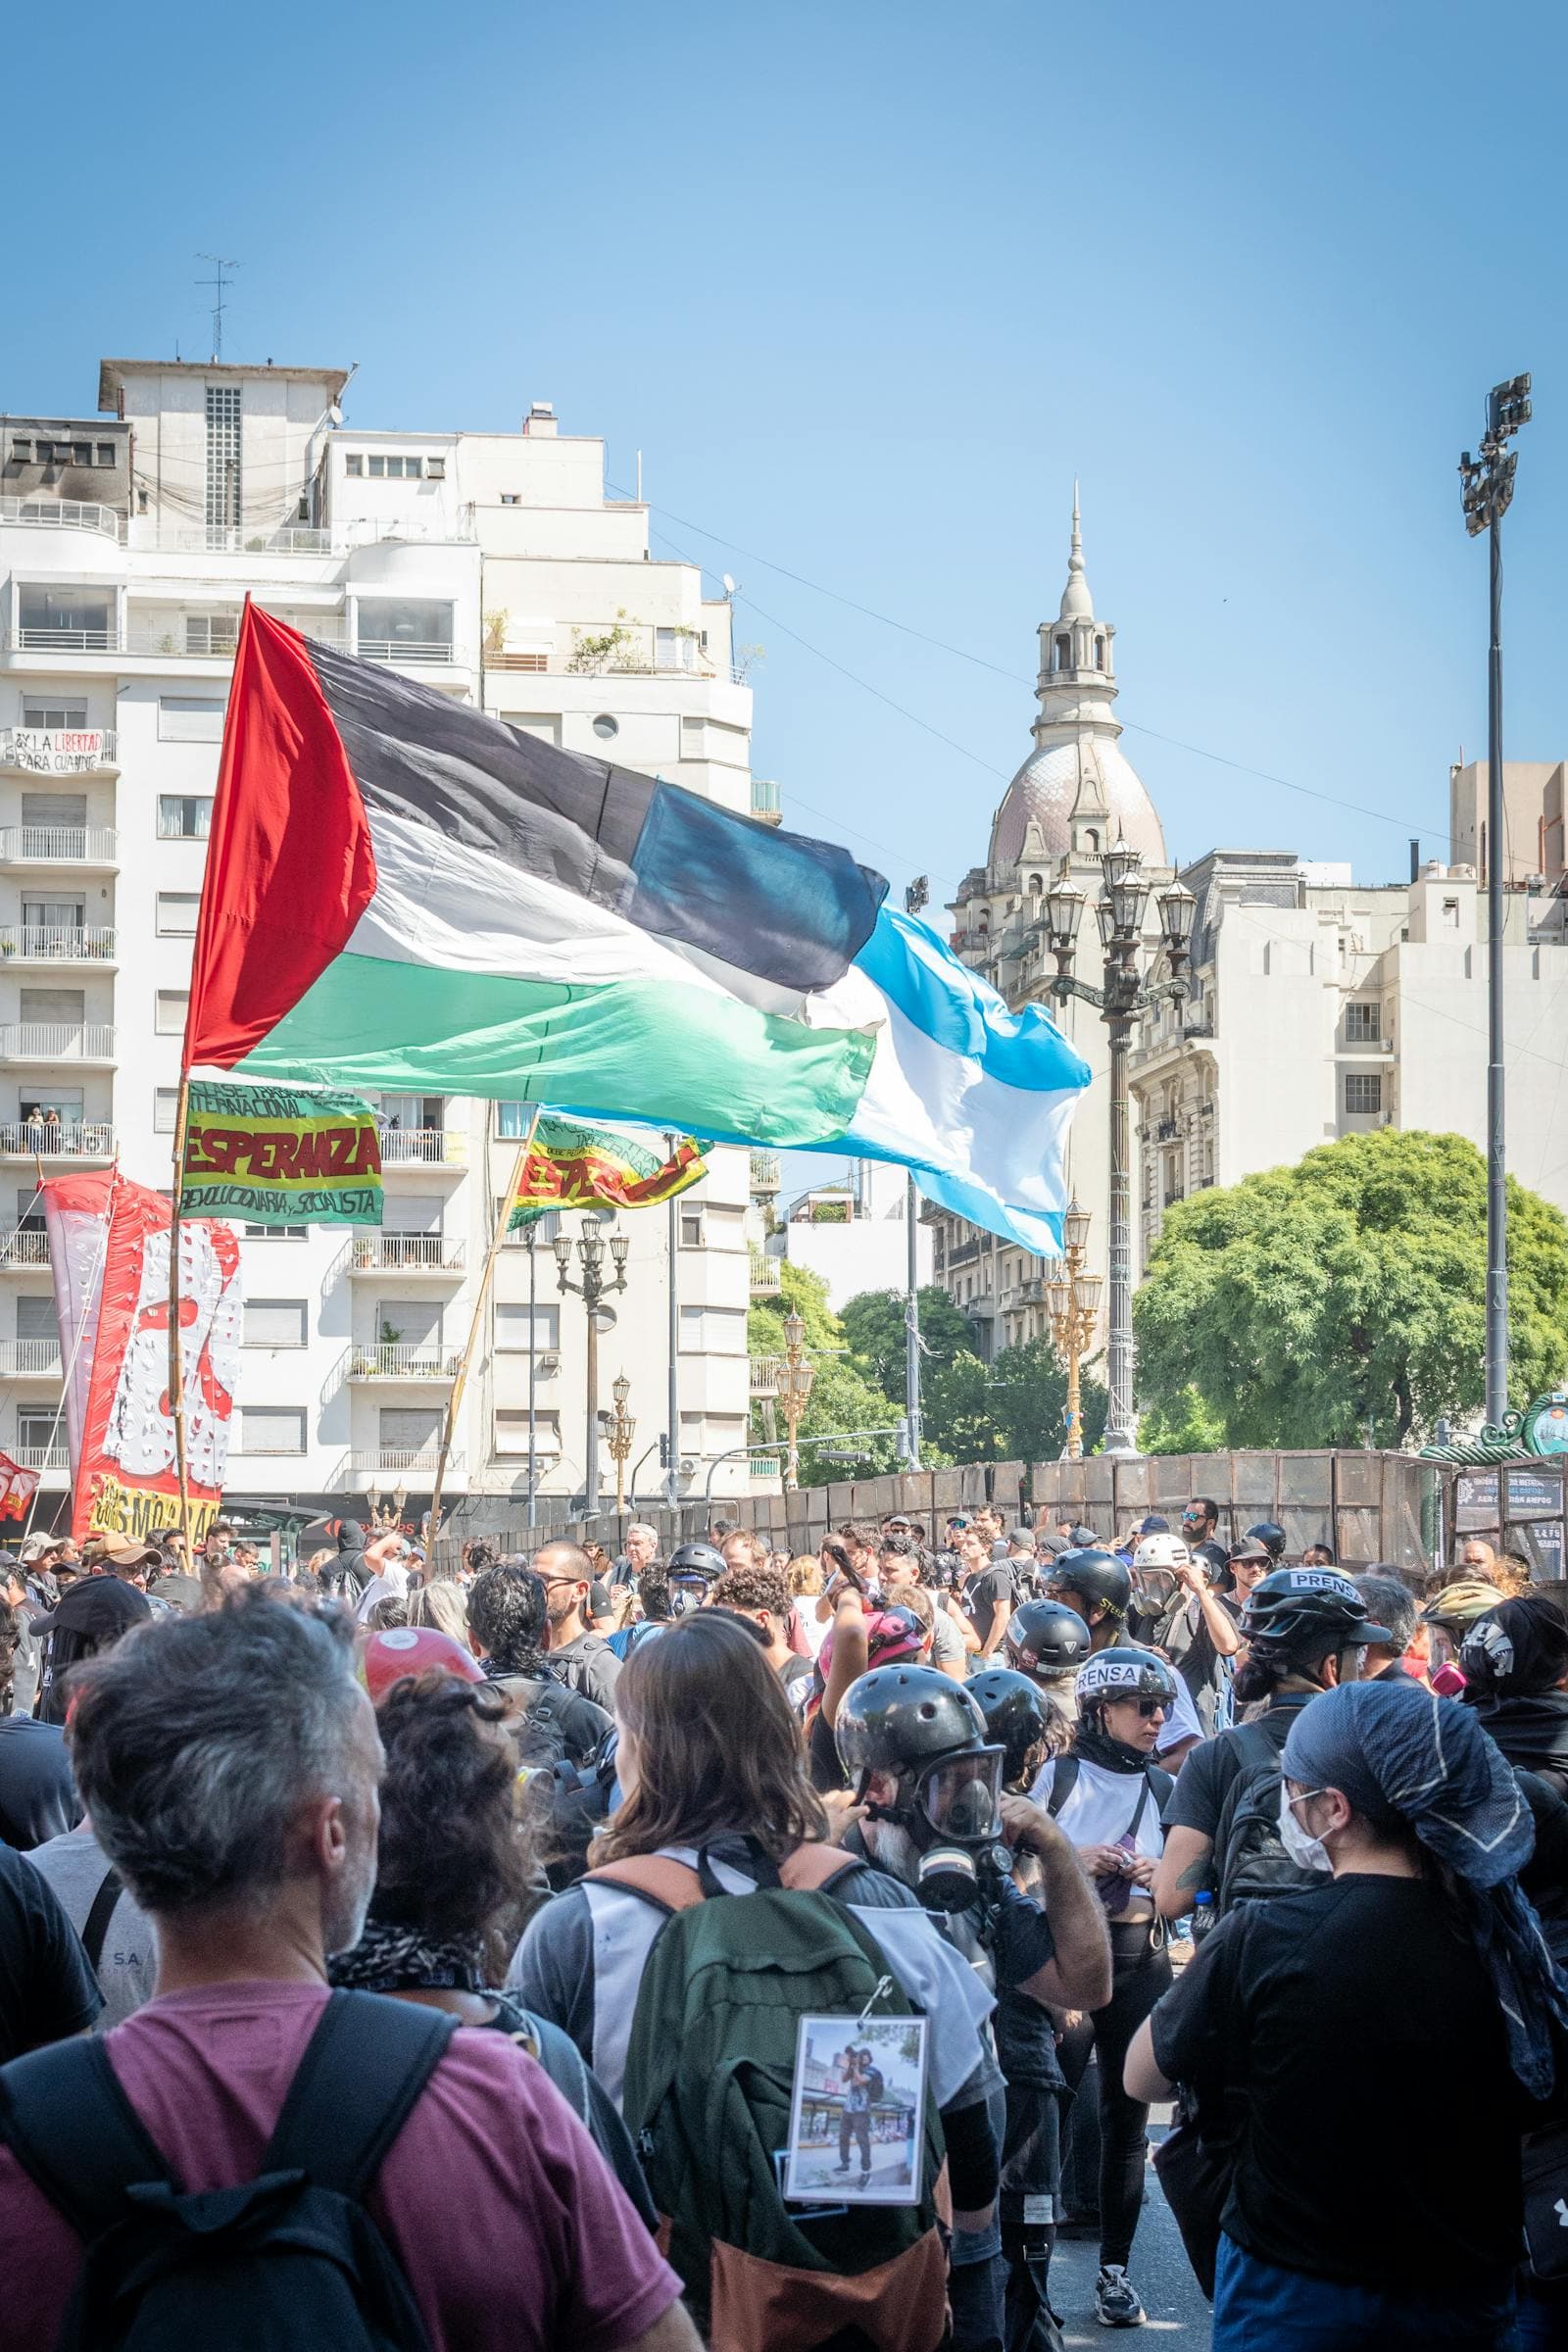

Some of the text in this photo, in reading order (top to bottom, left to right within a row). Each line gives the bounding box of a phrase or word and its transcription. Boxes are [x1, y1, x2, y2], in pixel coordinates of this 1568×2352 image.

[33, 735, 52, 752] LA
[16, 754, 51, 769] PARA
[184, 1125, 382, 1180] ESPERANZA
[293, 1189, 375, 1214] SOCIALISTA
[1297, 1574, 1366, 1604] PRENSA
[1078, 1666, 1138, 1689] RENSA
